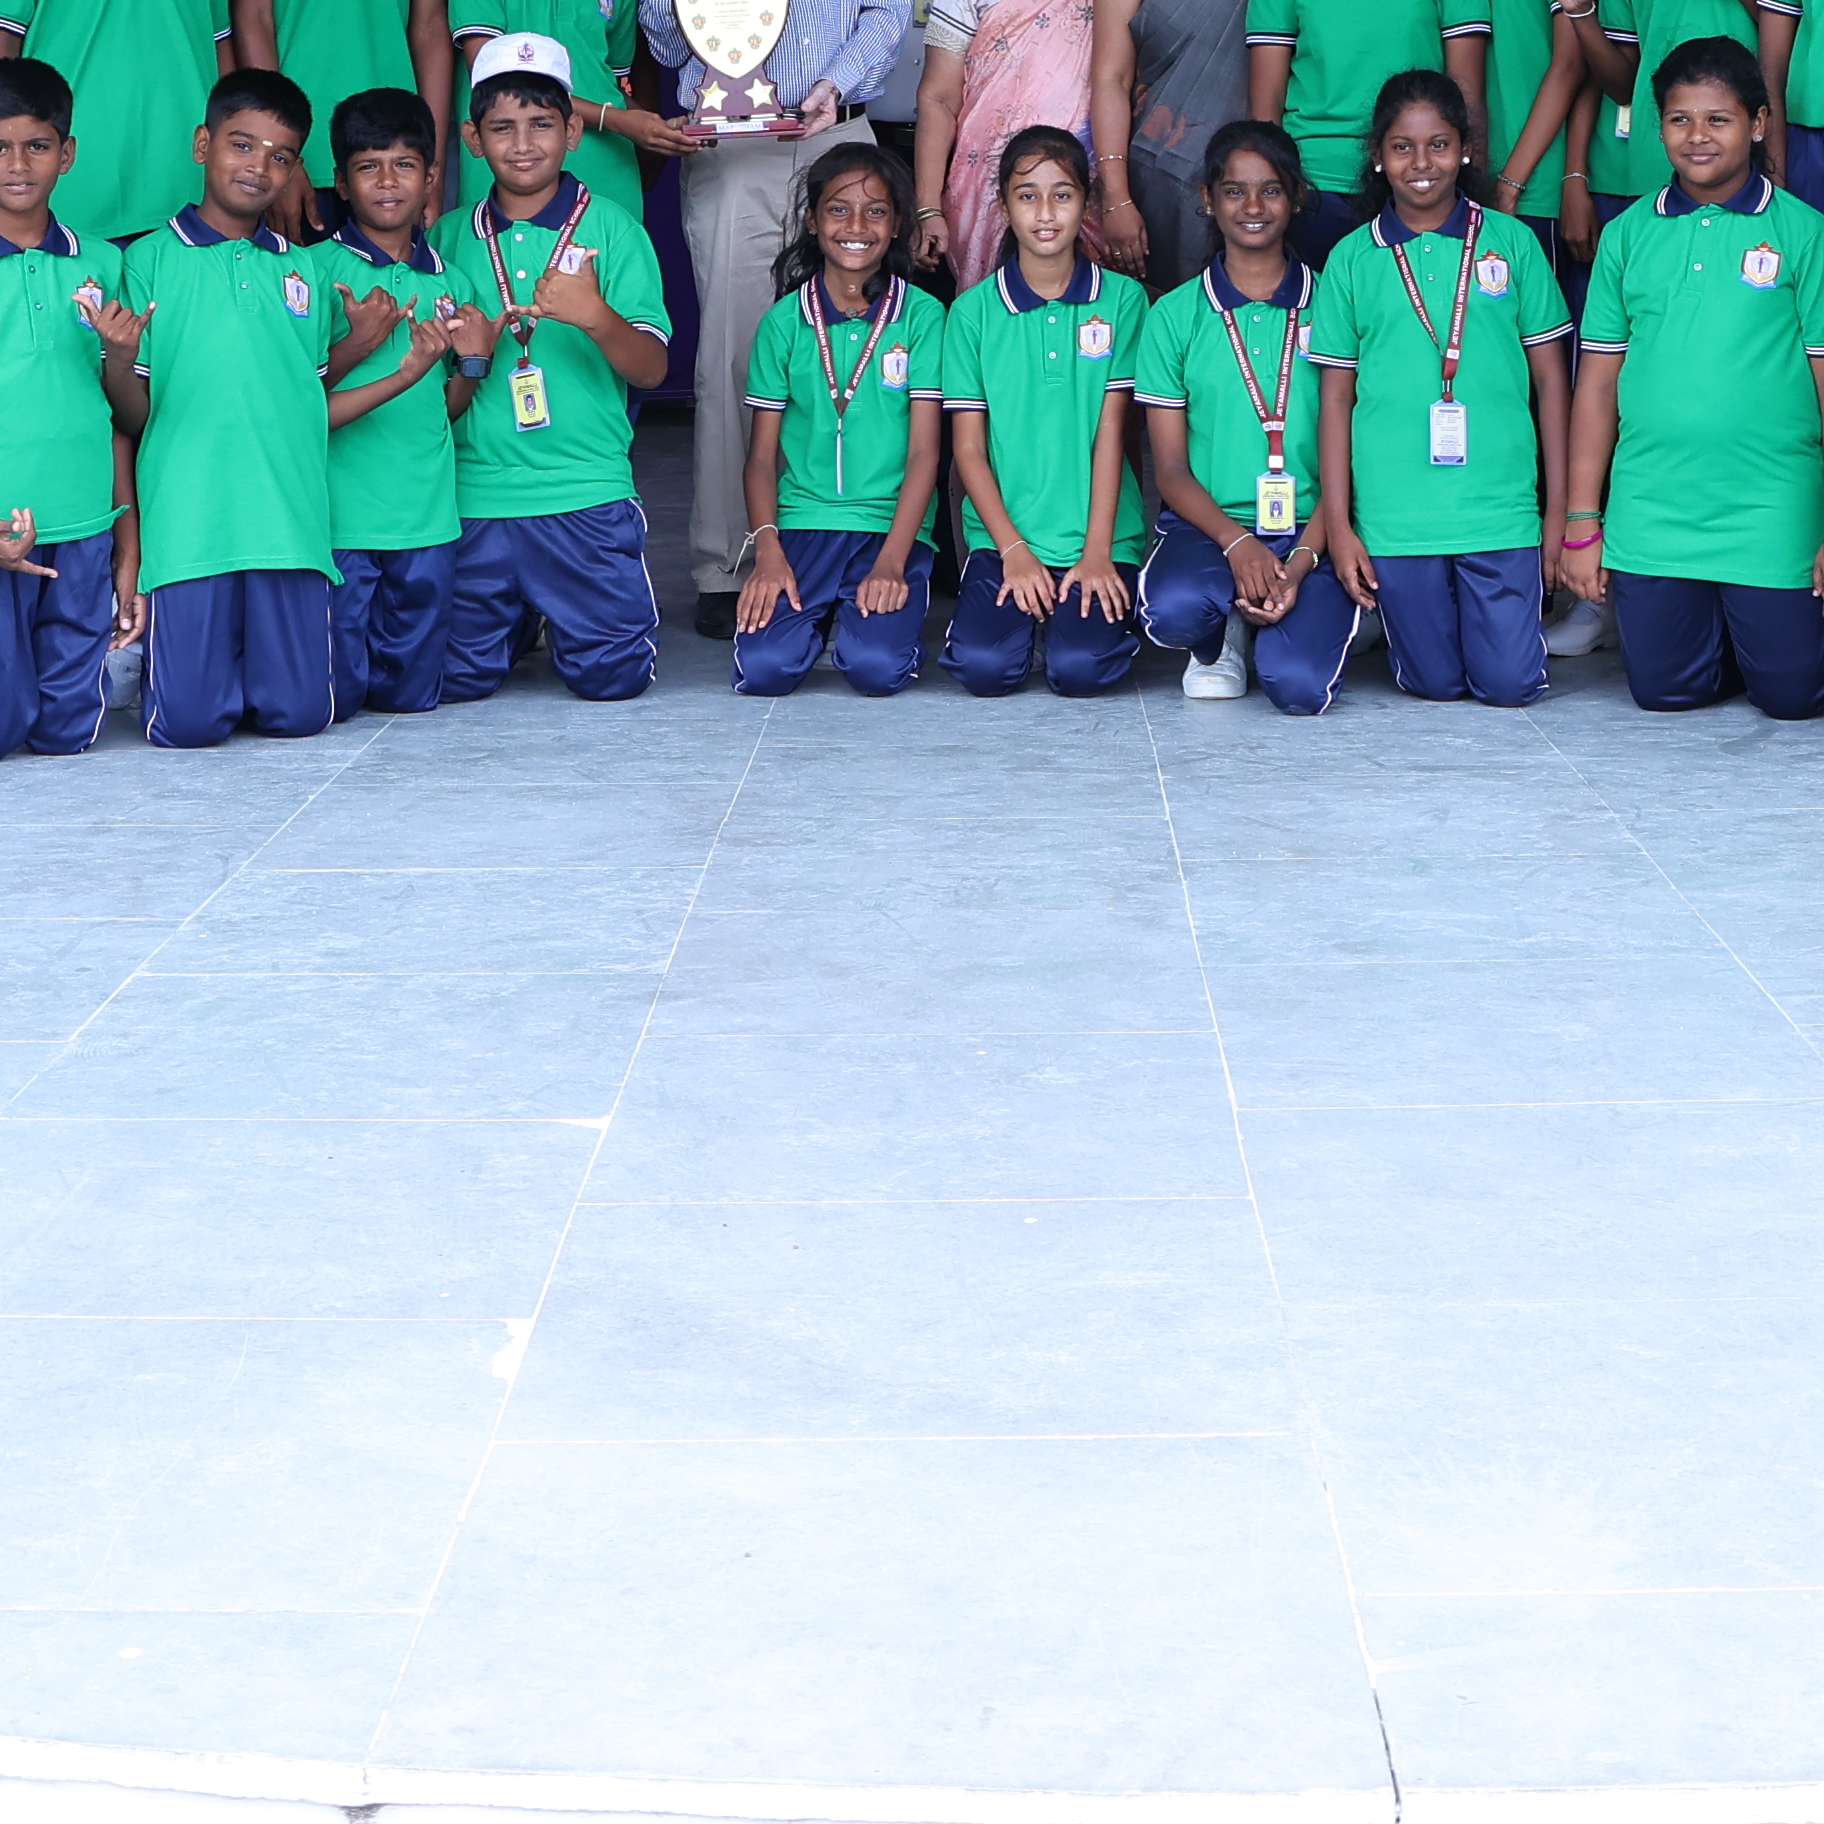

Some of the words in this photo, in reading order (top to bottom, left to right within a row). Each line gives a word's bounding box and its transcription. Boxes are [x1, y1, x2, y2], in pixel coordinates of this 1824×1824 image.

[548, 224, 572, 269] TERNATIONAL
[1451, 303, 1462, 345] JEYAMALLI
[1457, 248, 1470, 302] INTERNATIONAL
[1228, 324, 1250, 378] INTERNATIONAL
[1276, 376, 1286, 416] JEYAMALLI
[1281, 320, 1294, 374] INTERNATIONAL
[1247, 379, 1266, 419] JEYAMALLI
